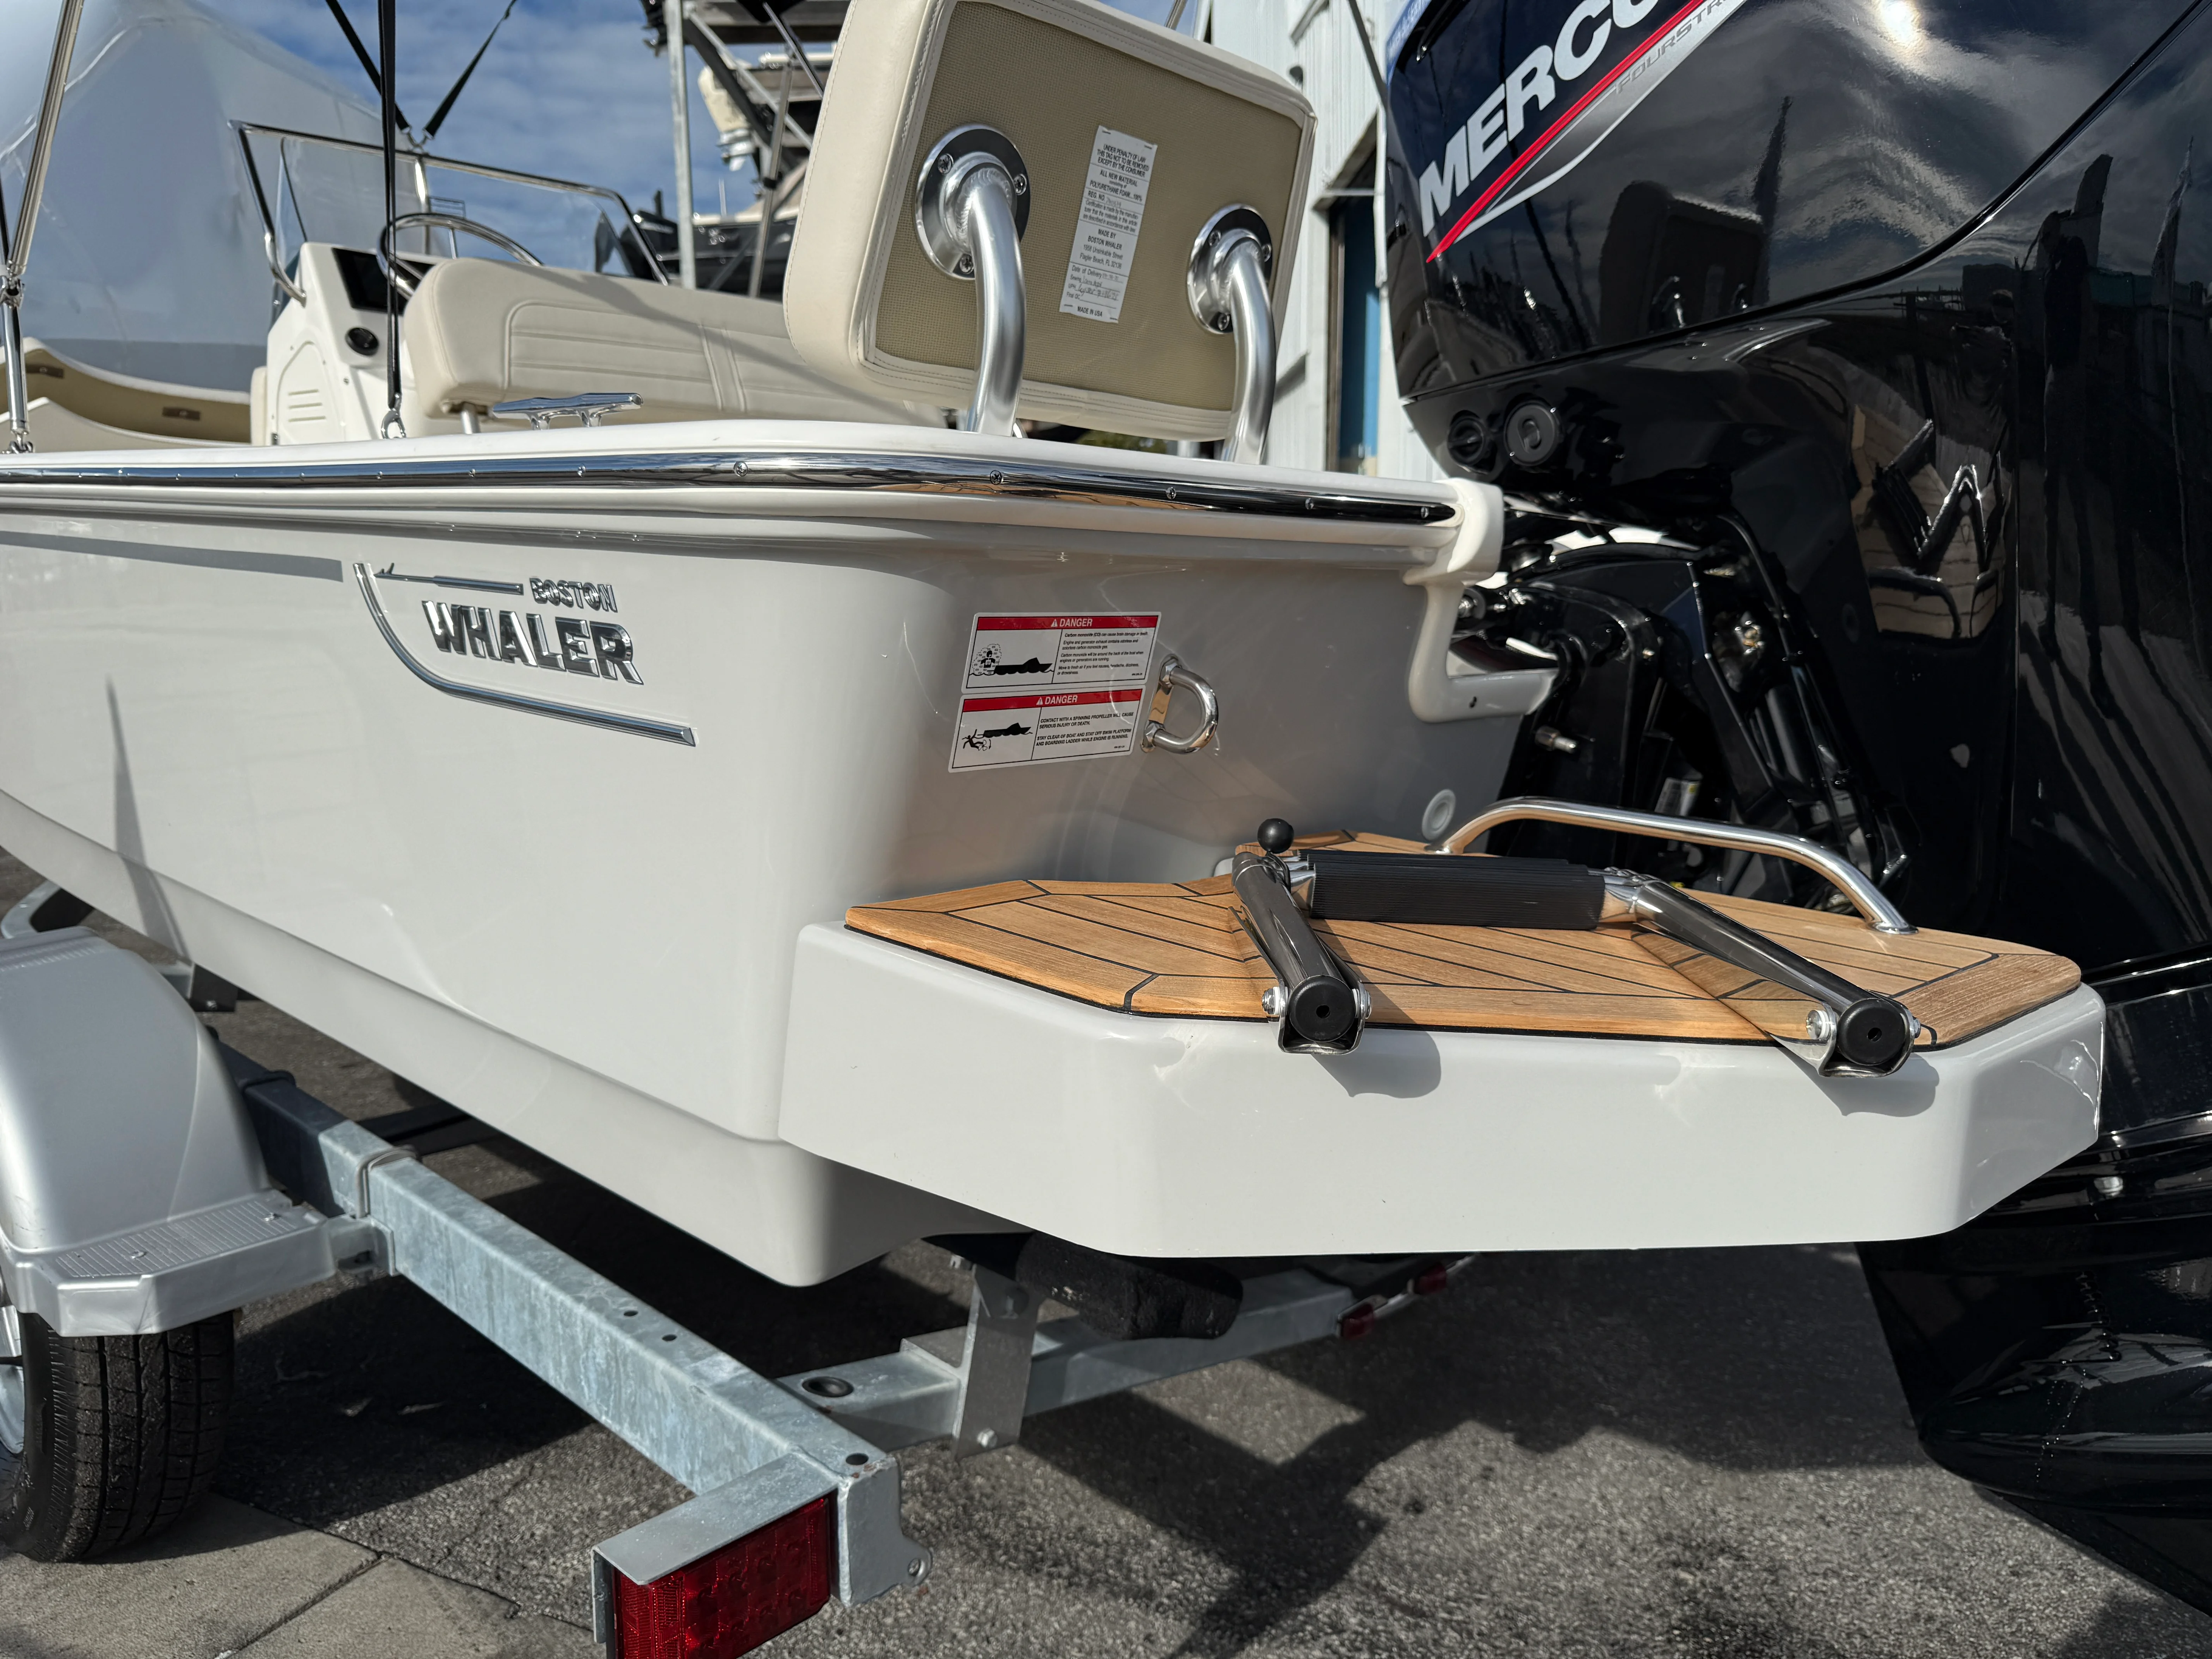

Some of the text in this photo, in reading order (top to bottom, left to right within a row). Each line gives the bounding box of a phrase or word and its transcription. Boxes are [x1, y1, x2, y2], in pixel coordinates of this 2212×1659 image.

[1616, 0, 1726, 94] FOURSTR
[1103, 144, 1116, 153] UNDER
[1098, 157, 1112, 166] EXCEPT
[1118, 175, 1137, 186] MATERIAL
[1098, 229, 1109, 237] MADE
[1088, 235, 1122, 250] BOSTON WHALER
[529, 577, 618, 613] BOSTON
[1059, 618, 1093, 627] DANGER
[421, 600, 644, 685] WHALER
[1044, 694, 1078, 705] DANGER
